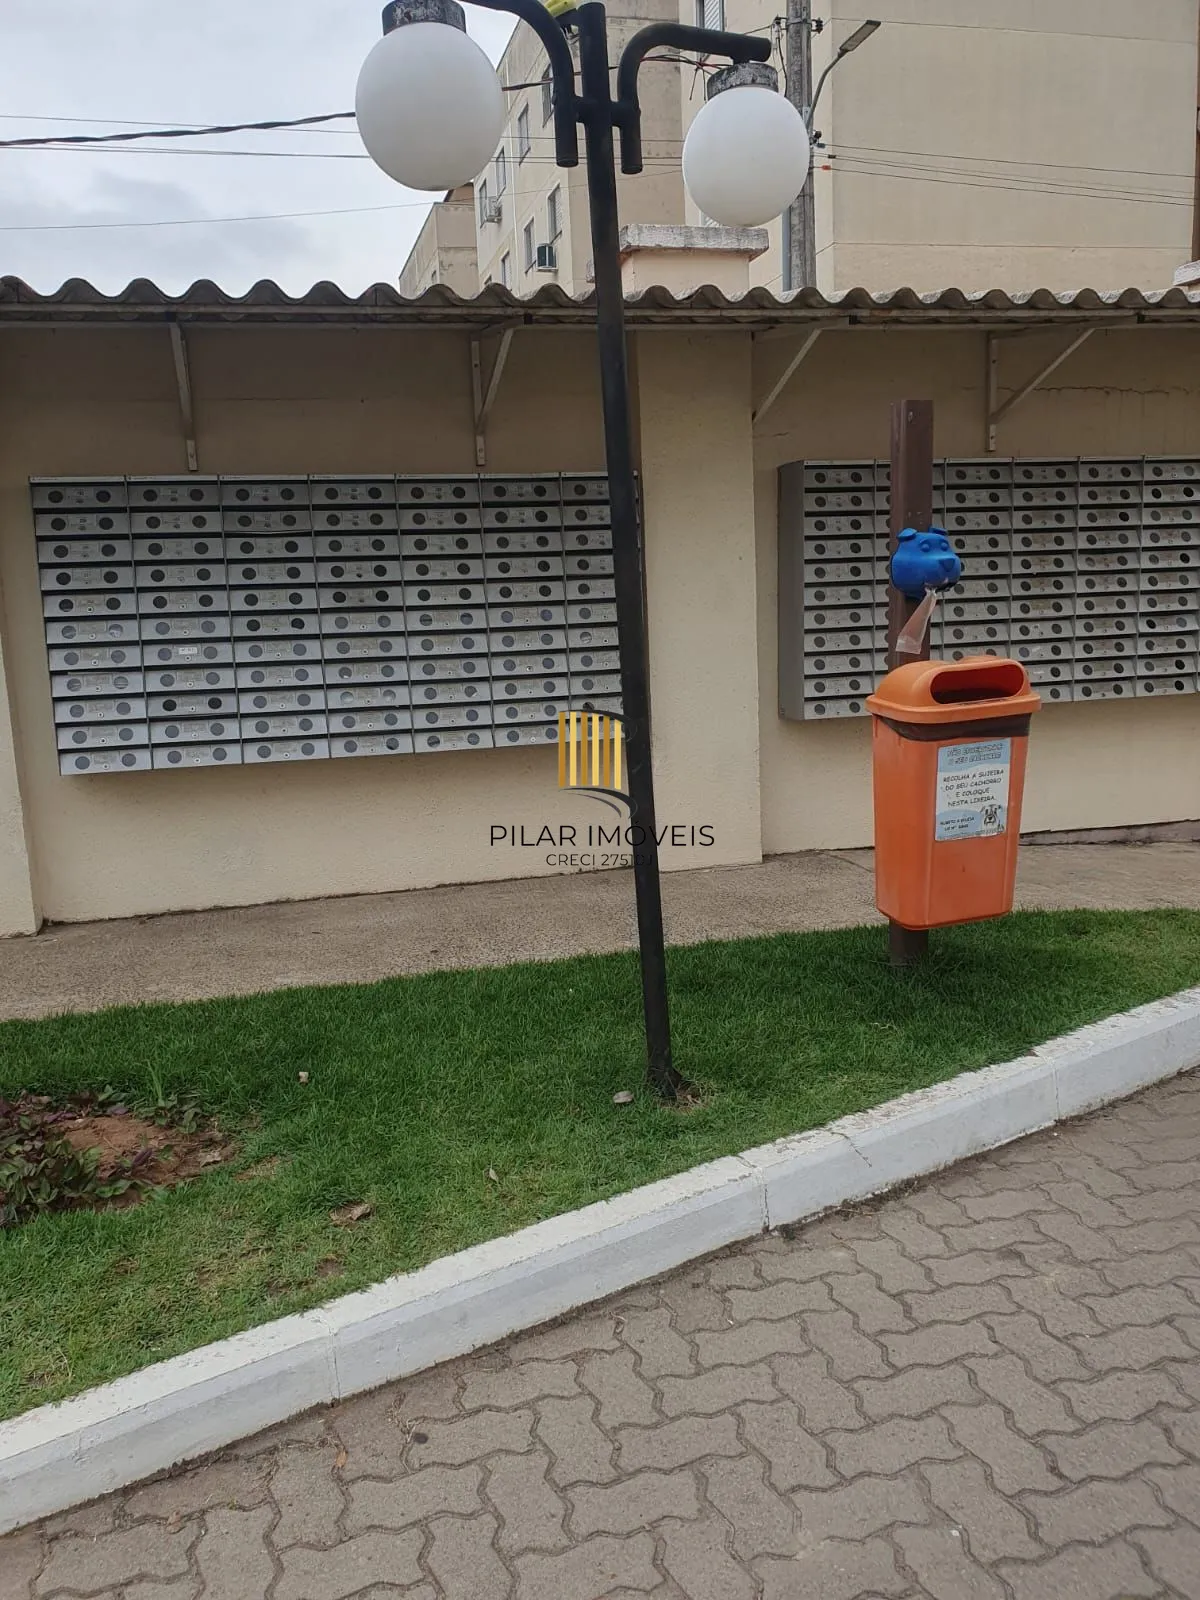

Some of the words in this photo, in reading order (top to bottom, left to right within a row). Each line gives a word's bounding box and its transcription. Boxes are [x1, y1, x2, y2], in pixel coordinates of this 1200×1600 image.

[943, 773, 970, 783] RECOLHA
[978, 769, 1004, 778] SUJEIRA
[970, 777, 1002, 787] CACHORRO
[962, 787, 990, 797] COLOQUE
[947, 799, 968, 807] NESTA
